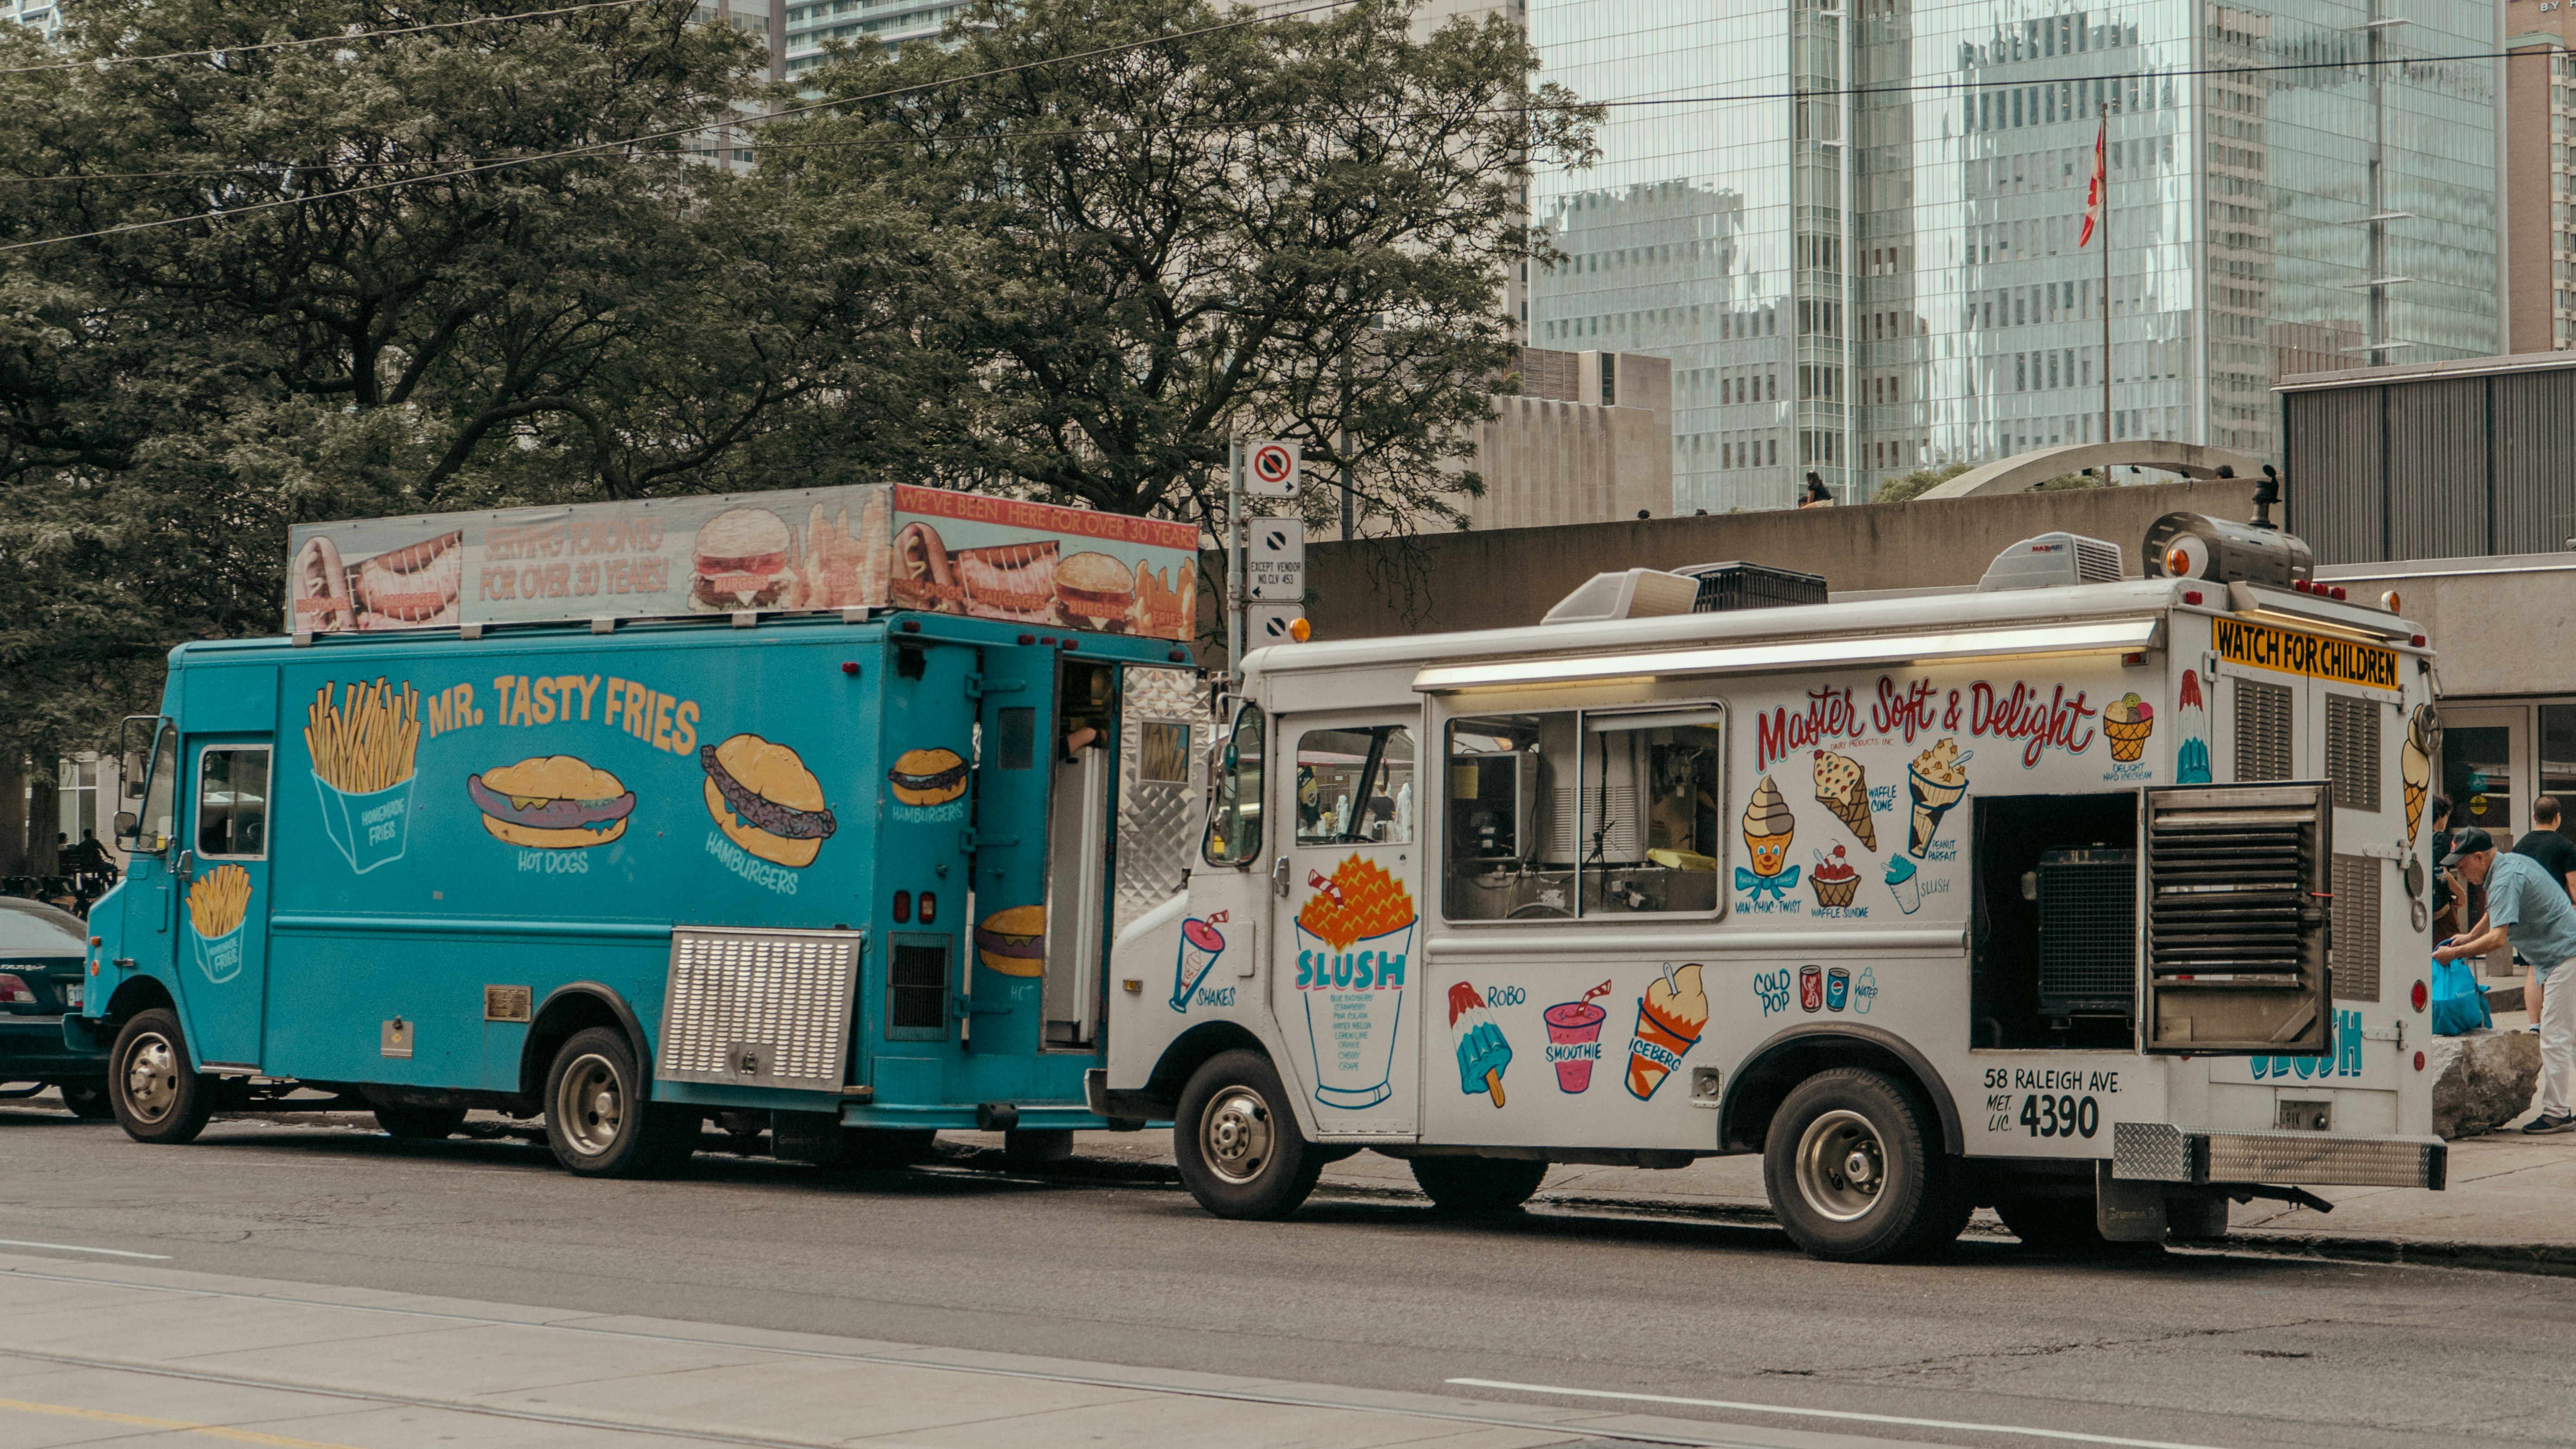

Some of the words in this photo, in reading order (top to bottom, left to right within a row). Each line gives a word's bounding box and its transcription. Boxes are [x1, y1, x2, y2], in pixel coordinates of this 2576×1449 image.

[2541, 1, 2559, 12] BY
[900, 489, 952, 513] WE'VE
[957, 498, 998, 520] BEEN
[1008, 504, 1046, 528] HERE
[1051, 510, 1081, 530] FOR
[1085, 514, 1125, 538] OVER
[1130, 520, 1148, 541] 30
[1153, 524, 1197, 548] YEARS
[484, 523, 564, 560] SERVING
[568, 517, 663, 555] TORONTO
[1251, 562, 1273, 572] EXCEPT
[1277, 562, 1301, 572] VENDOR
[480, 566, 516, 601] FOR
[520, 562, 570, 599] OVER
[574, 561, 600, 596] 30
[605, 557, 669, 594] YEARS!
[713, 575, 769, 593] BURGERS
[824, 570, 857, 588] FRIES
[1282, 574, 1293, 584] 453
[893, 579, 923, 598] HOT
[925, 583, 964, 602] DOGS
[977, 588, 1046, 610] SAUGAGES
[1068, 601, 1126, 621] BURGERS
[1153, 610, 1183, 627] FRIES
[2217, 619, 2280, 665] WATCH
[2284, 632, 2318, 673] FOR
[2320, 641, 2397, 687] CHILDREN
[428, 683, 484, 738] MR.
[494, 674, 601, 727] TASTY
[605, 677, 700, 756] FRIES
[1755, 684, 1866, 774] Master
[1871, 675, 1938, 746] Soft
[1941, 688, 1964, 734] &
[1968, 680, 2097, 770] Delight
[1830, 742, 1847, 751] DAIRY
[1849, 738, 1879, 750] PRODUCTS
[2112, 762, 2145, 773] DELIGHT
[1869, 785, 1897, 799] WAFFLE
[361, 798, 404, 827] HOMEMADE
[892, 802, 964, 824] HAMBURGERS
[1871, 799, 1893, 812] CONE
[369, 821, 396, 846] FRIES
[1932, 840, 1956, 850] PEANUT
[518, 850, 543, 873] HOT
[546, 851, 589, 875] DOGS
[705, 832, 799, 896] HAMBURGERS
[1928, 850, 1957, 862] PARFAIT
[1920, 879, 1950, 898] SLUSH
[1811, 908, 1841, 919] WAFFLE
[1843, 907, 1869, 919] SUNDAE
[1295, 949, 1406, 991] SLUSH
[1754, 969, 1790, 995] COLD
[1854, 983, 1878, 1000] WATER
[1196, 986, 1235, 1007] SHAKES
[1488, 986, 1525, 1008] ROBO
[1761, 990, 1789, 1018] POP
[1333, 1022, 1350, 1030] WATER
[1335, 1032, 1353, 1040] LEMON
[1355, 1031, 1368, 1040] LIME
[1338, 1051, 1361, 1060] CHERRY
[1545, 1042, 1602, 1062] SMOOTHIE
[1629, 1037, 1682, 1071] ICEBERG
[1339, 1061, 1359, 1071] GRAPE
[1984, 1068, 2008, 1089] 58
[2015, 1068, 2082, 1090] RALEIGH
[2089, 1071, 2122, 1093] AVE.
[1986, 1094, 2013, 1112] MET.
[1988, 1114, 2012, 1132] LIC.
[2020, 1094, 2099, 1139] 4390
